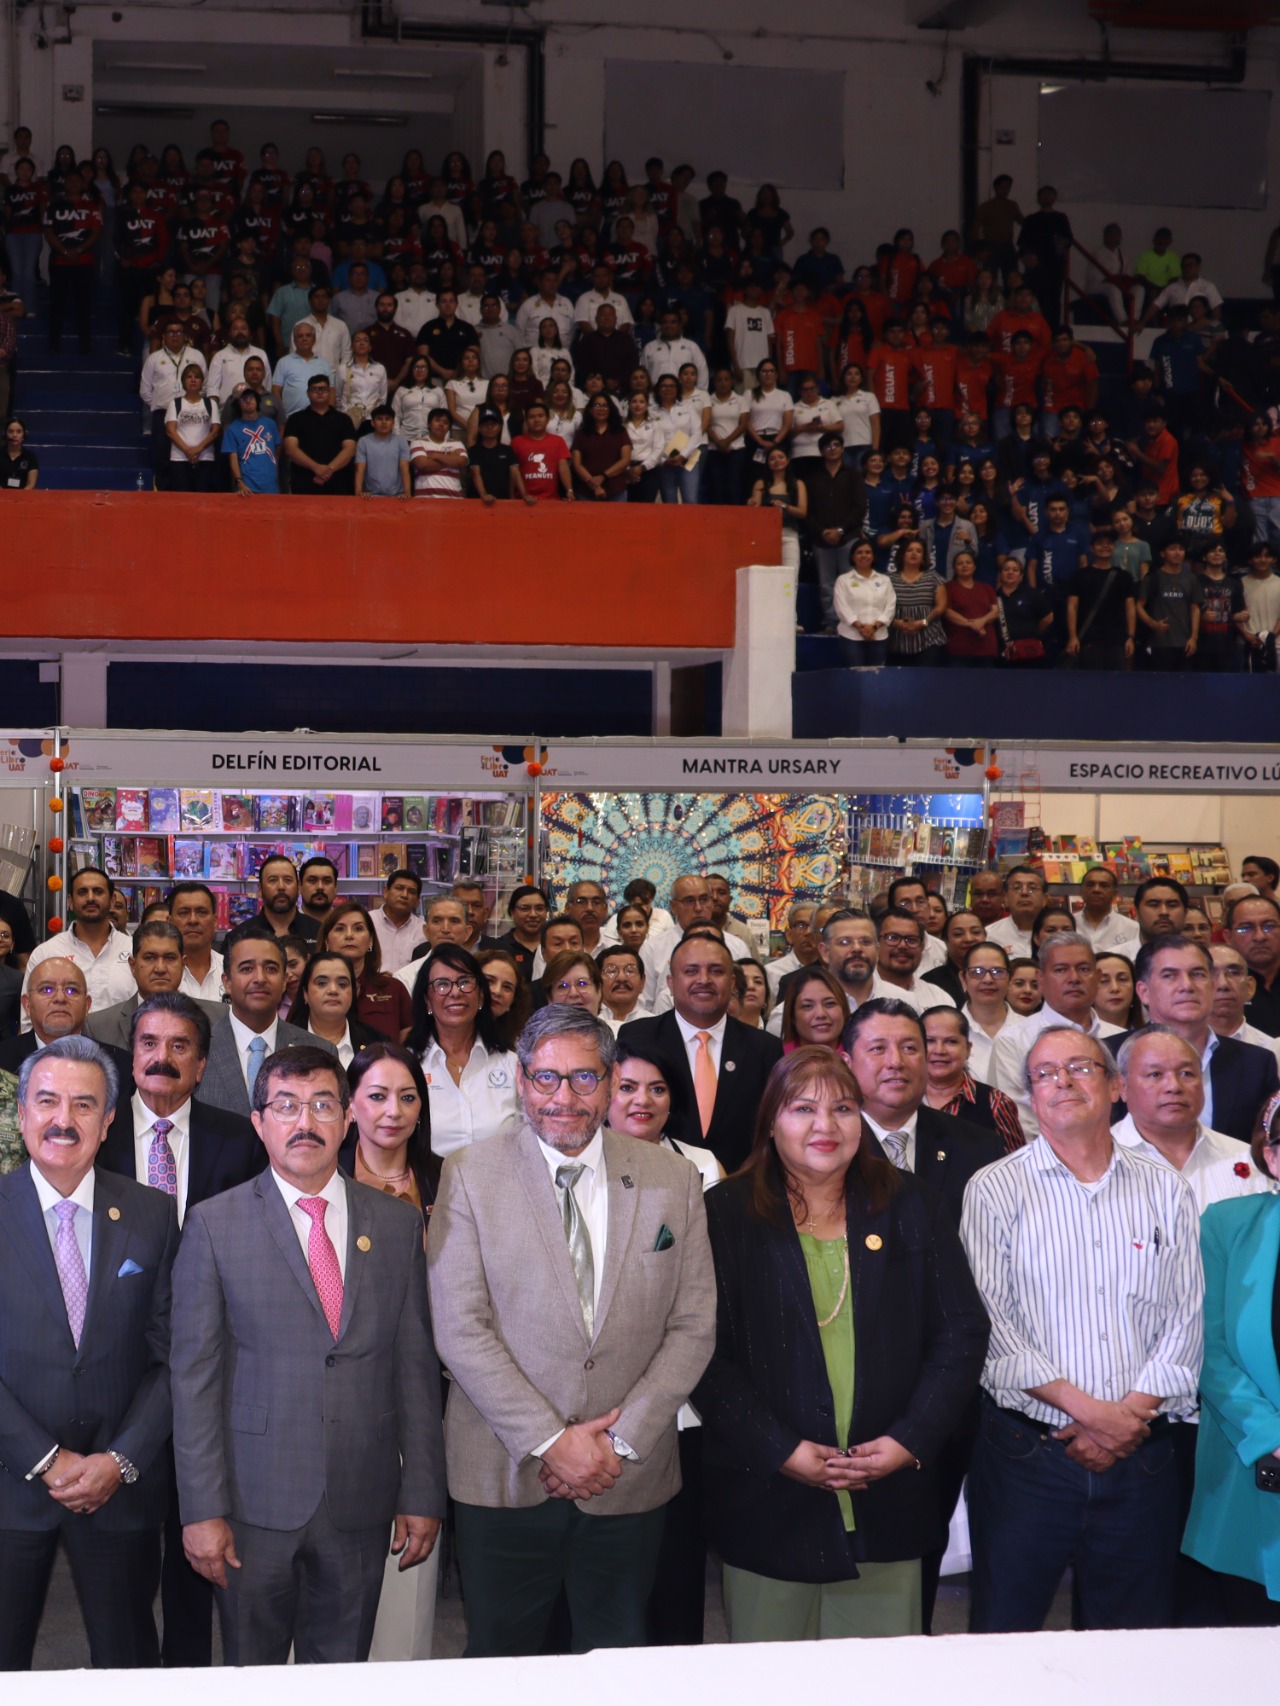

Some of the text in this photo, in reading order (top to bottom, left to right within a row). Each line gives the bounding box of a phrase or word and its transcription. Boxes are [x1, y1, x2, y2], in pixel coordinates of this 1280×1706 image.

[10, 191, 38, 203] UAT
[56, 209, 90, 221] UAT
[127, 219, 156, 230] UAT
[245, 217, 272, 228] UAT
[189, 228, 218, 240] UAT
[480, 254, 505, 265] UAT
[785, 329, 796, 366] BGUAT
[885, 363, 896, 404] BGUAT
[524, 472, 554, 480] PEANUTS
[9, 763, 26, 771] UAT
[212, 750, 382, 772] DELFÍN EDITORIAL
[682, 758, 842, 775] MANTRA URSARY
[492, 770, 509, 778] UAT
[1070, 763, 1144, 779] ESPACIO
[1149, 764, 1257, 781] RECREATIVO
